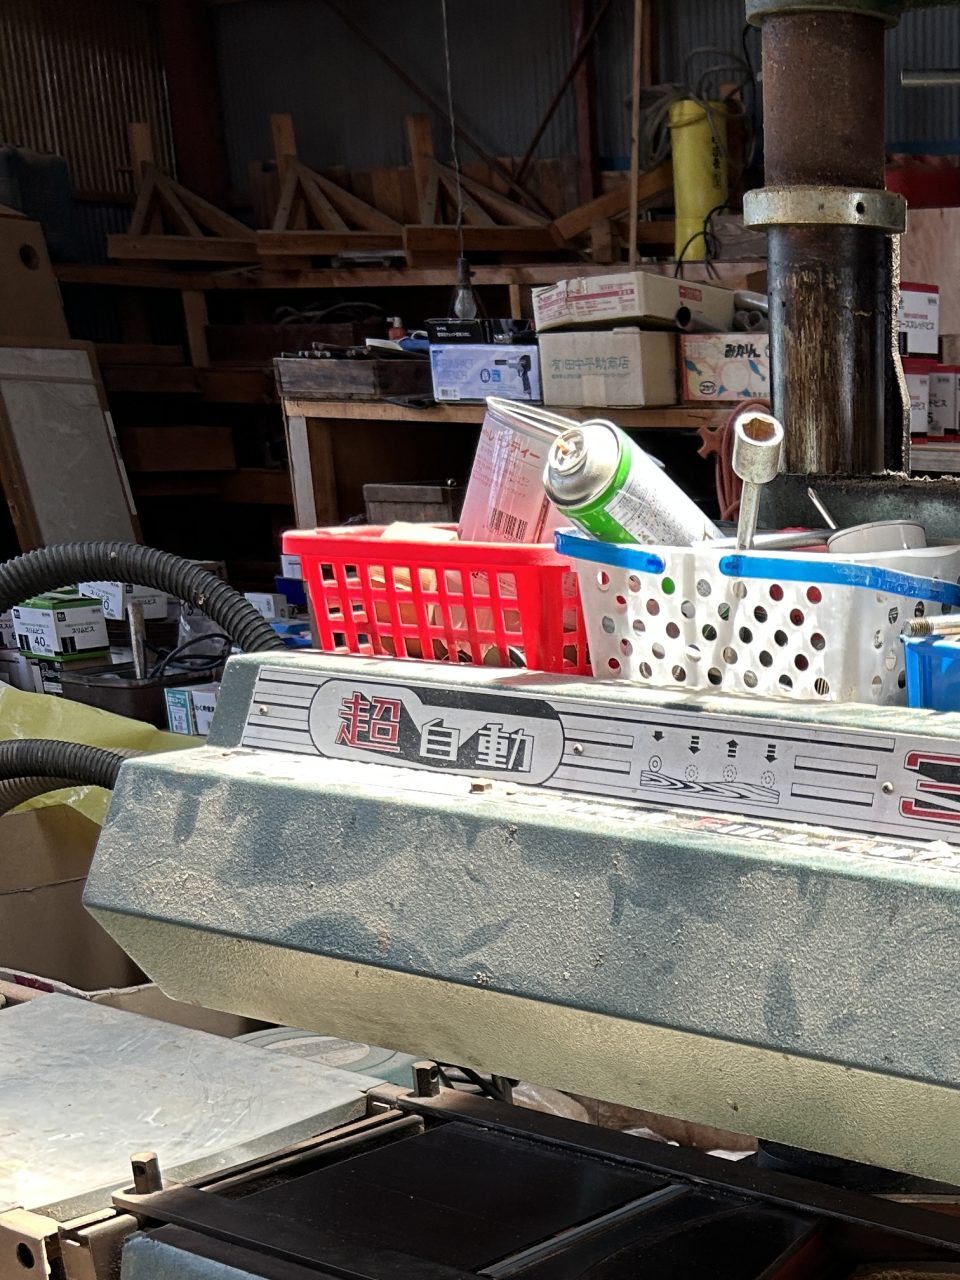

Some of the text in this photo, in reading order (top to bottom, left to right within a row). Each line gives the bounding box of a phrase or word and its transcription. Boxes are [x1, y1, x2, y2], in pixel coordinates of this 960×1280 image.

[34, 636, 46, 647] 40
[336, 691, 534, 773] 超自動
